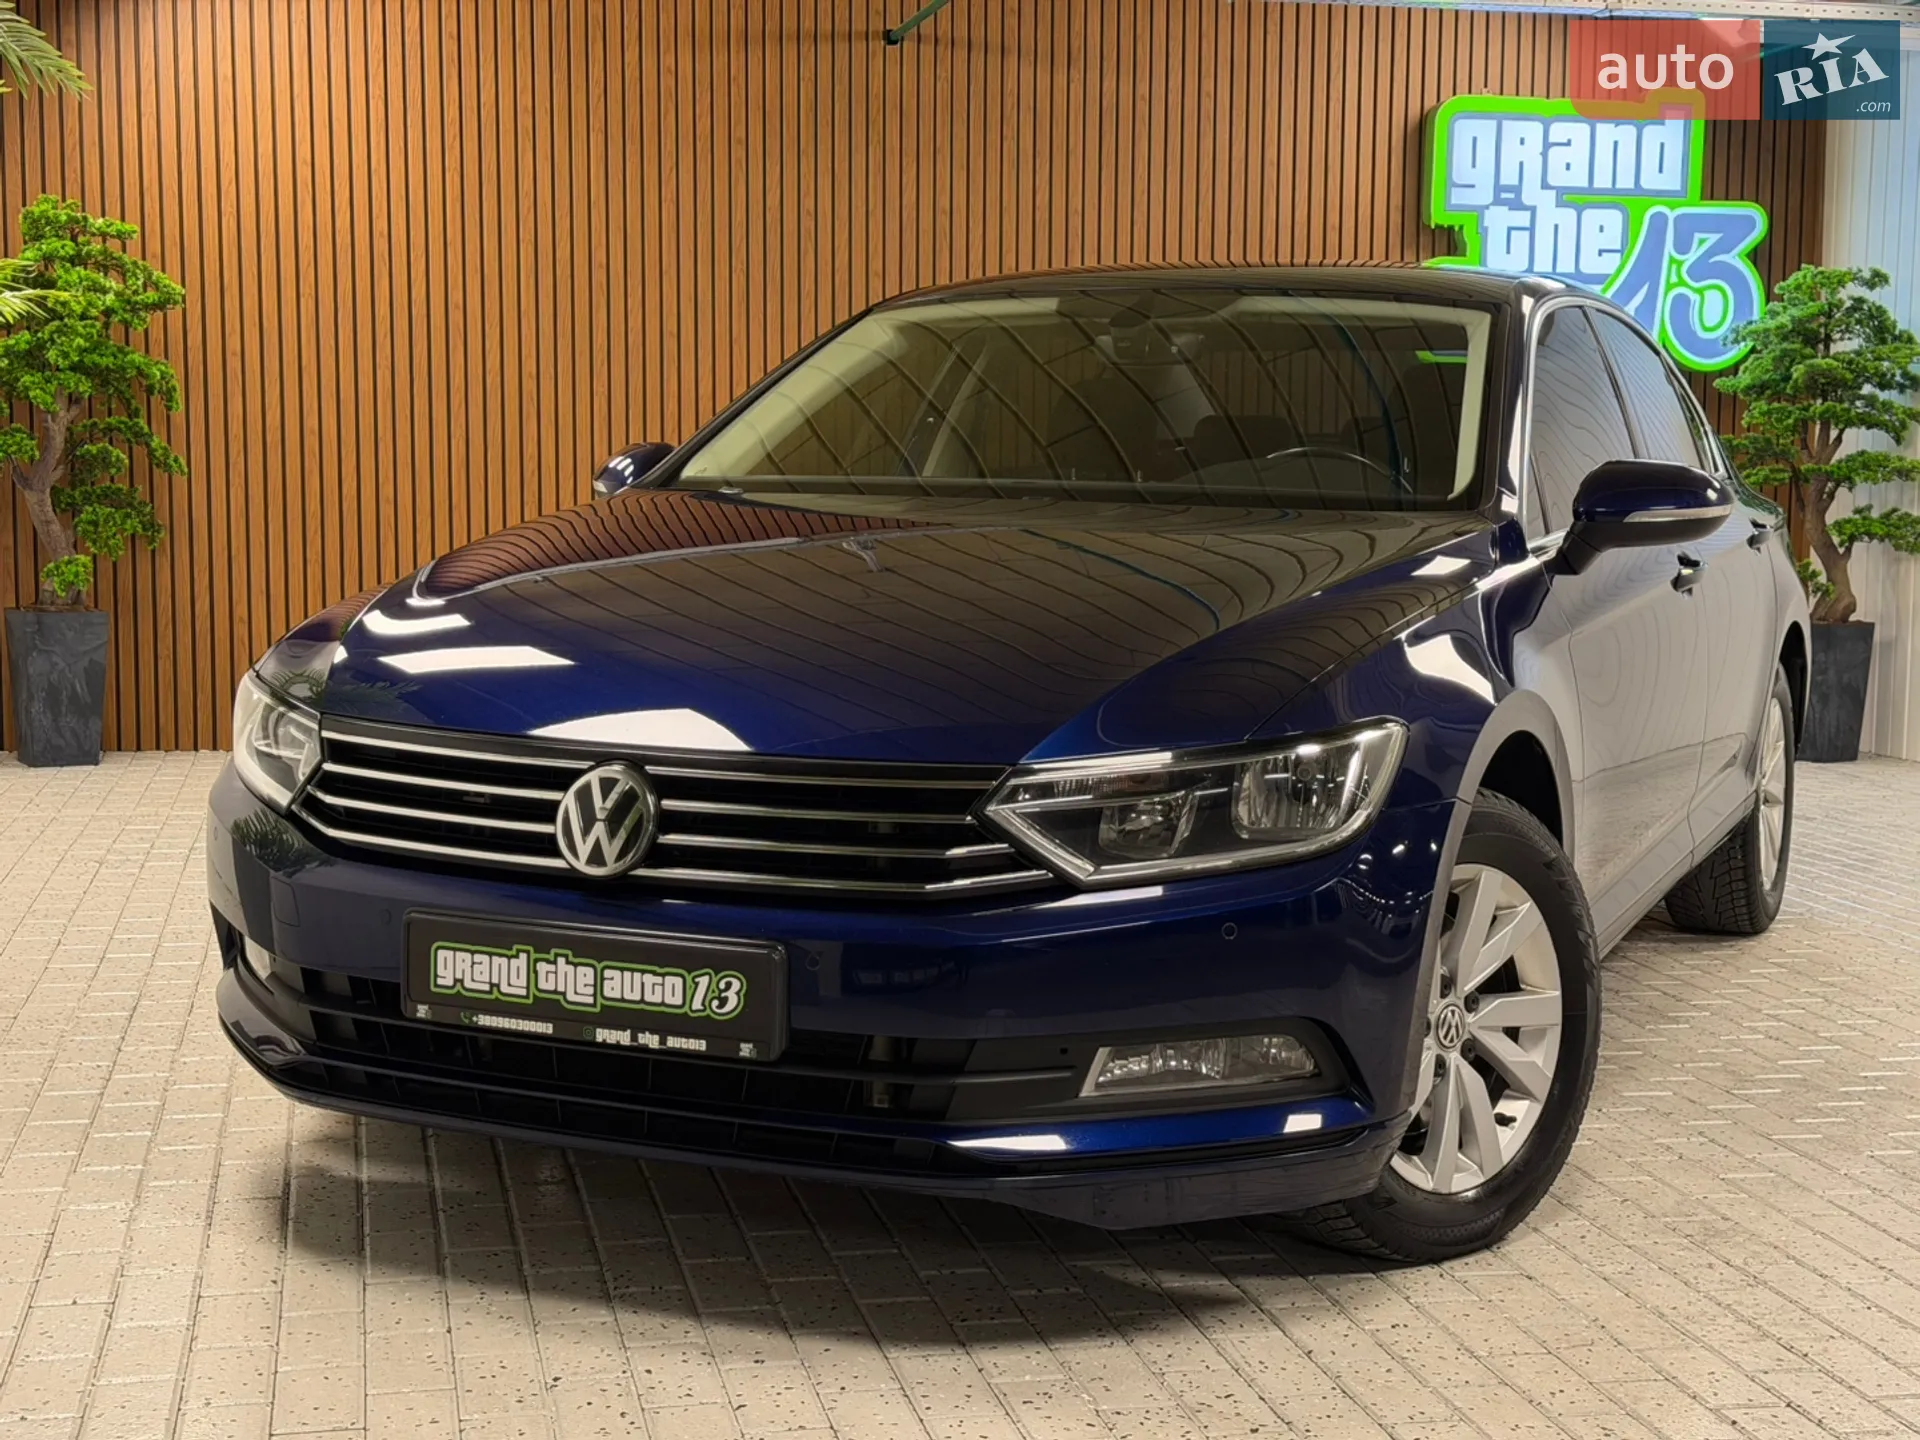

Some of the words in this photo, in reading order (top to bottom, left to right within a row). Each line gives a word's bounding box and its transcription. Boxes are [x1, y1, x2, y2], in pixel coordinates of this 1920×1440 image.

[1484, 190, 1623, 274] the
[1603, 205, 1763, 364] 13
[536, 957, 595, 1004] the
[603, 969, 684, 1005] auto
[691, 974, 742, 1015] 13
